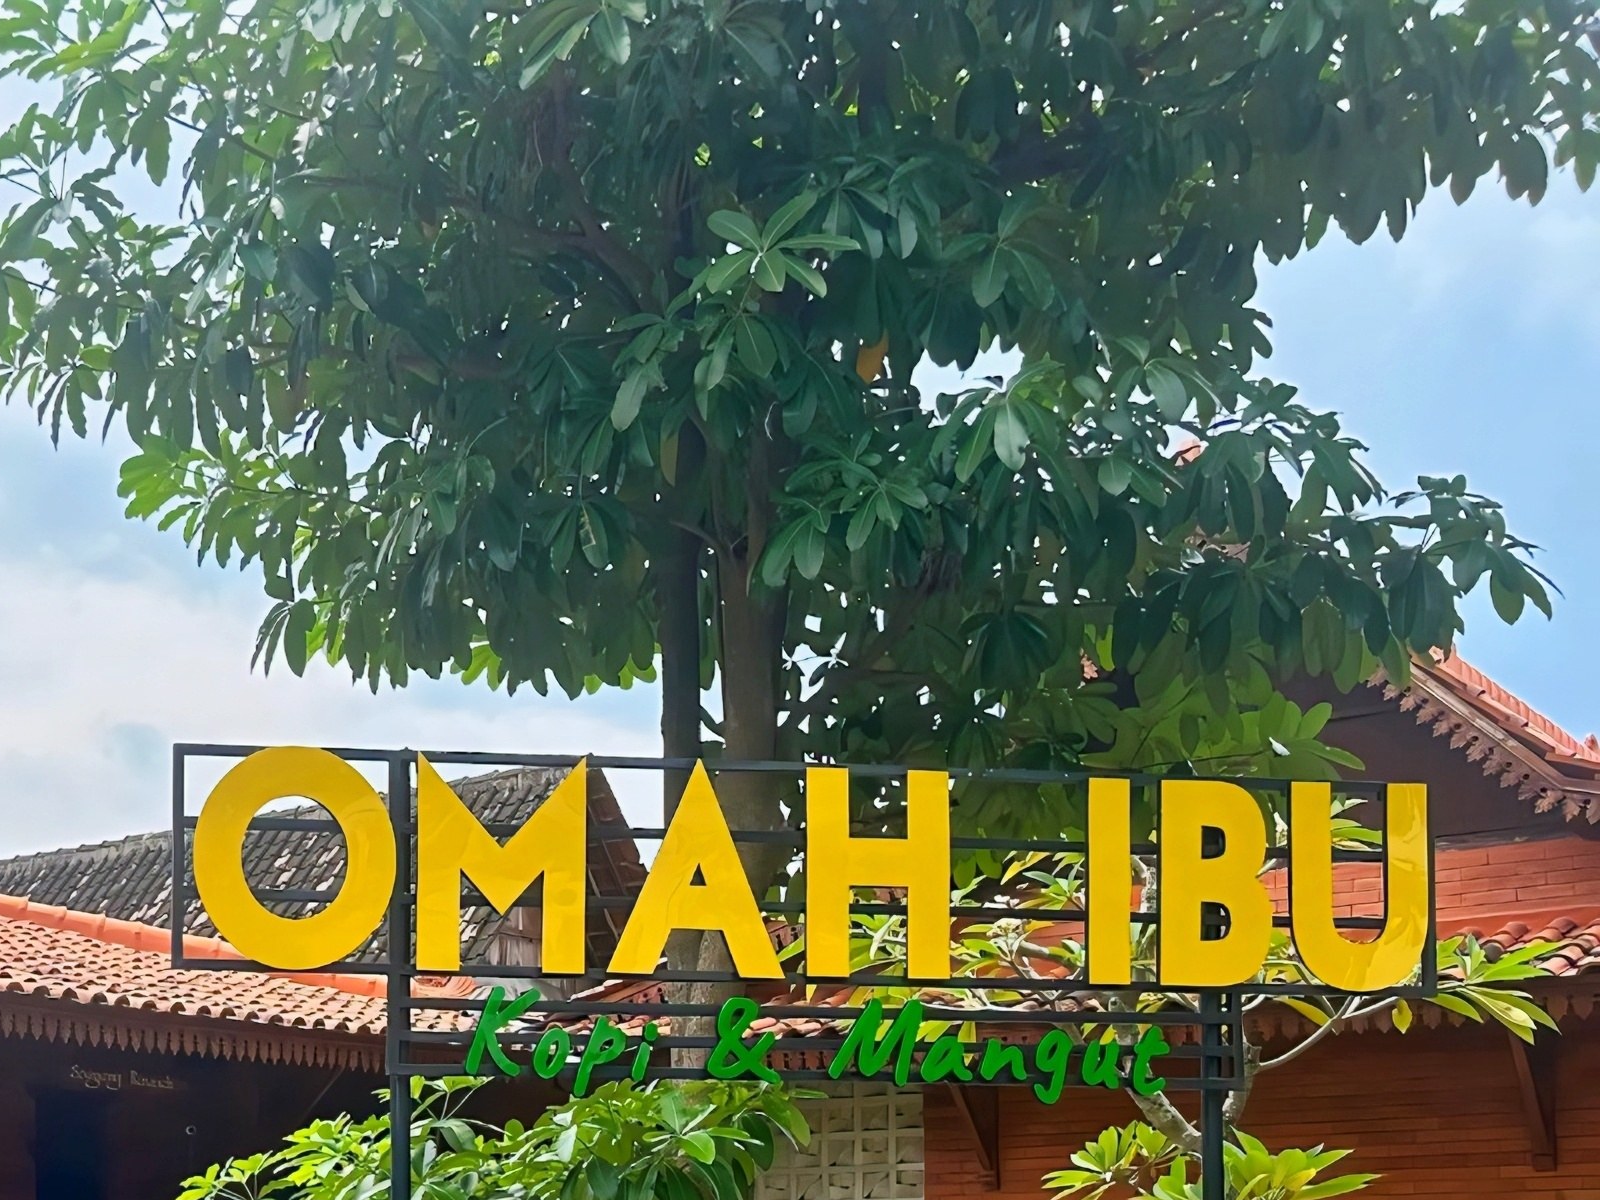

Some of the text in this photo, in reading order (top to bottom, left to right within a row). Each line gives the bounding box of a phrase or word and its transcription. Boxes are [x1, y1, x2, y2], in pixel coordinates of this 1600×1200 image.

[192, 746, 1429, 992] OMAH IBU
[465, 986, 1171, 1105] Kopi & Mangut
